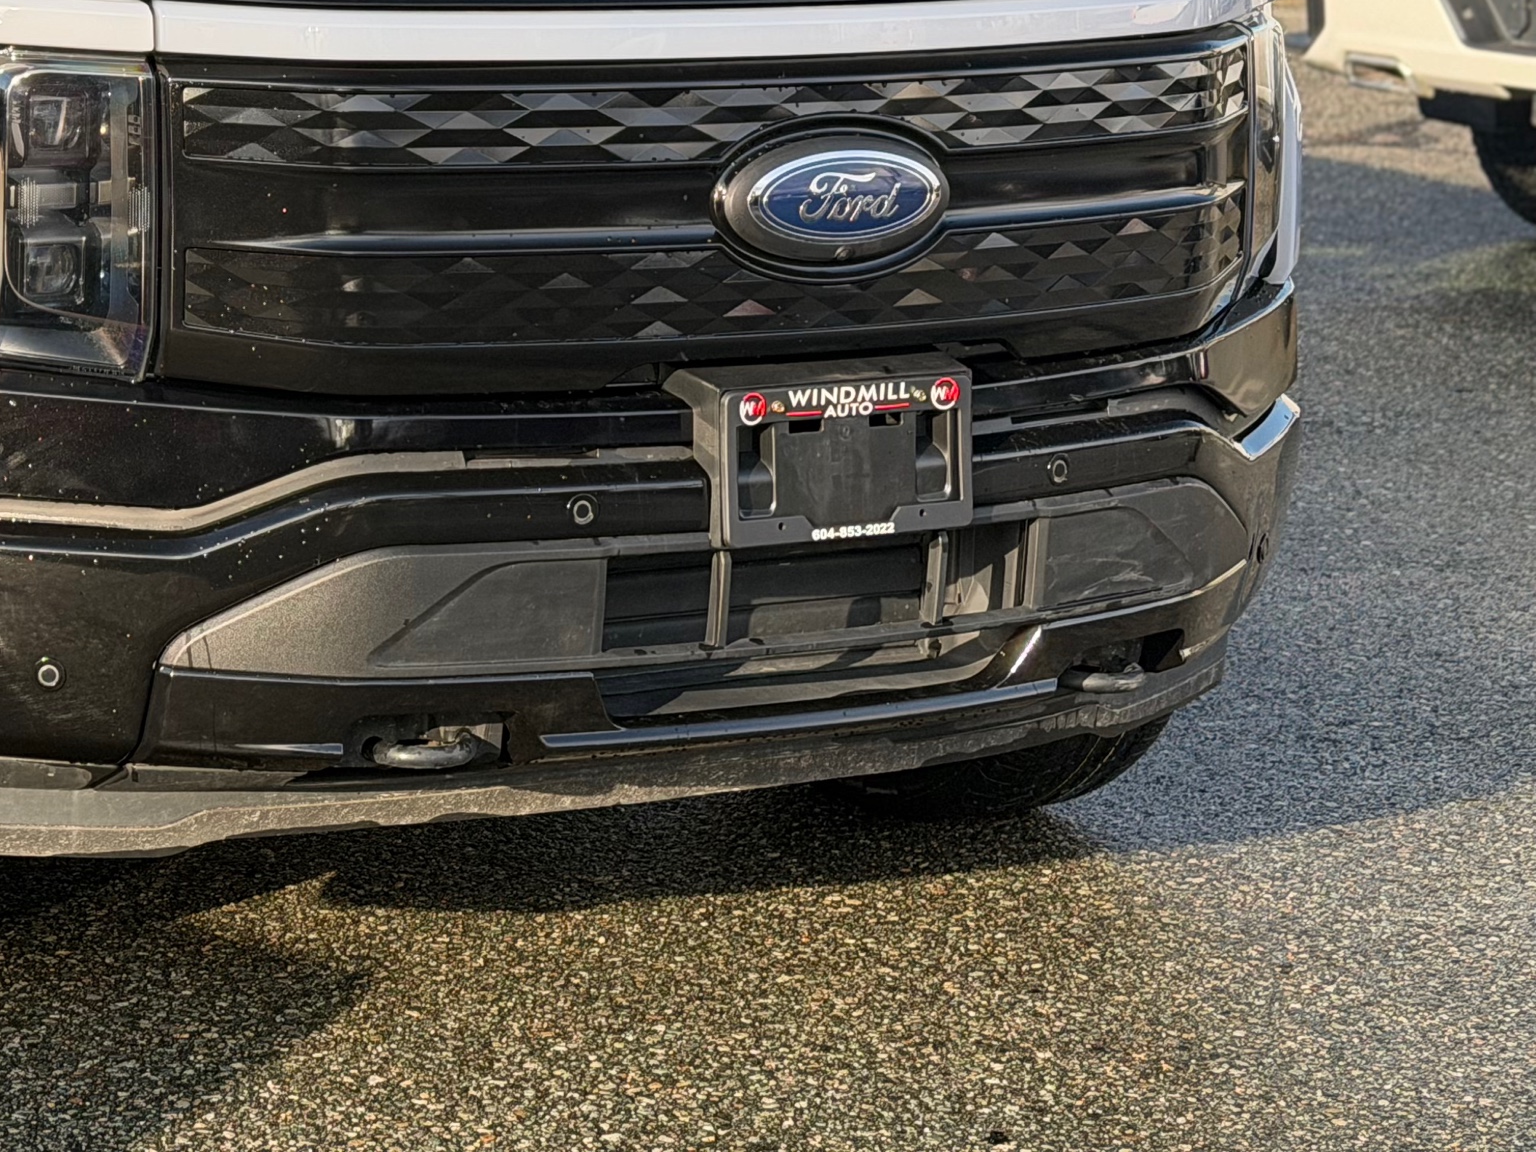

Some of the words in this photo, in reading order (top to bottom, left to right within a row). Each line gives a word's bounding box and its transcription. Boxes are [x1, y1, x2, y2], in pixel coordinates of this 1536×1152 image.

[799, 171, 901, 222] Ford
[788, 381, 910, 408] WINDMILL
[823, 401, 874, 419] AUTO
[811, 522, 895, 541] 604-853-2022
